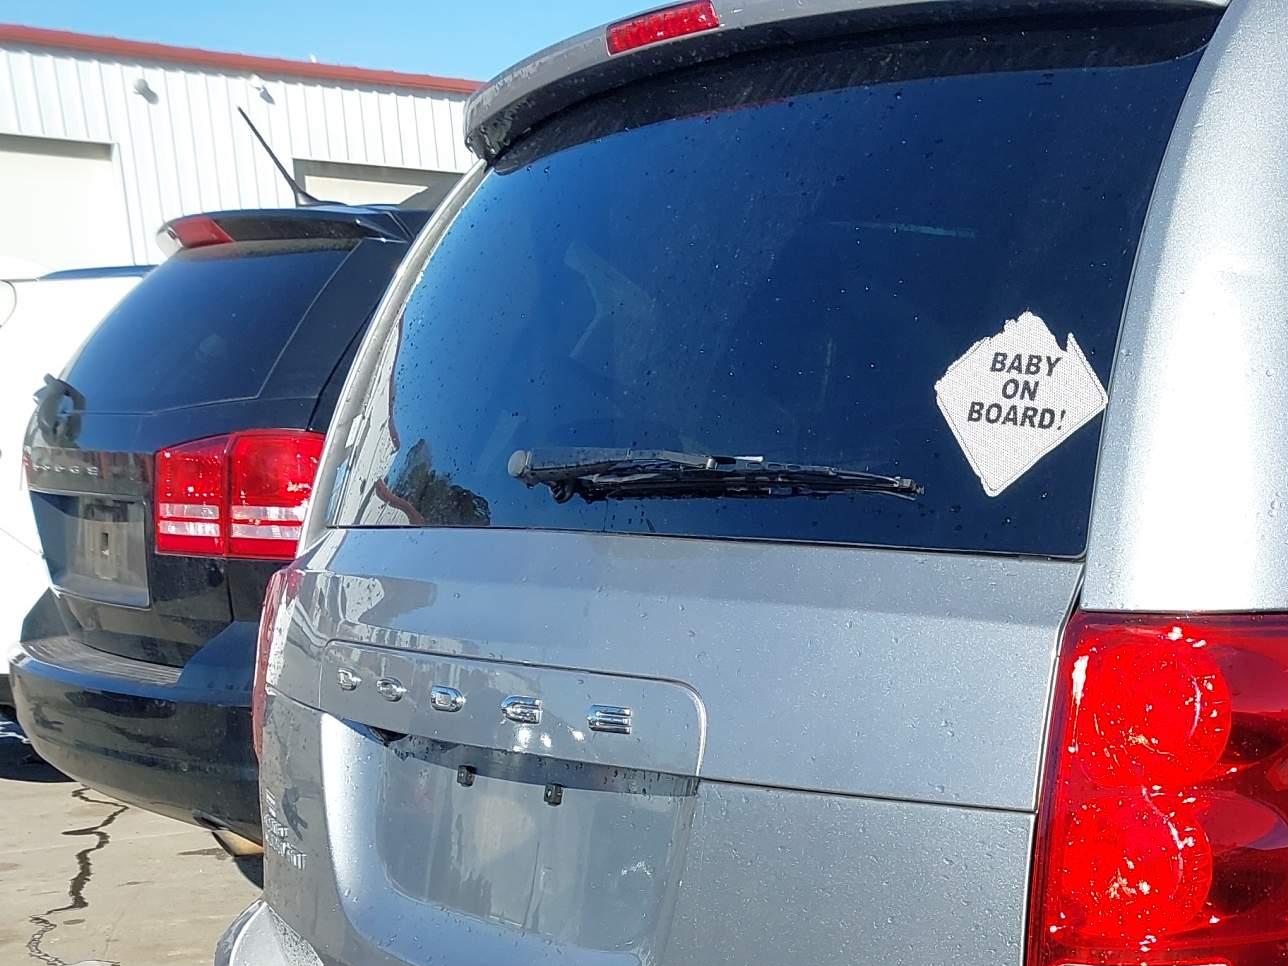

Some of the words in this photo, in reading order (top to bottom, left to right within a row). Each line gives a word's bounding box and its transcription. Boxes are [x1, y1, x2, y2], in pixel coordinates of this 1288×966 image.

[990, 352, 1062, 377] BABY
[1001, 378, 1040, 401] ON
[967, 401, 1066, 431] BOARD!
[337, 667, 633, 735] DODGE
